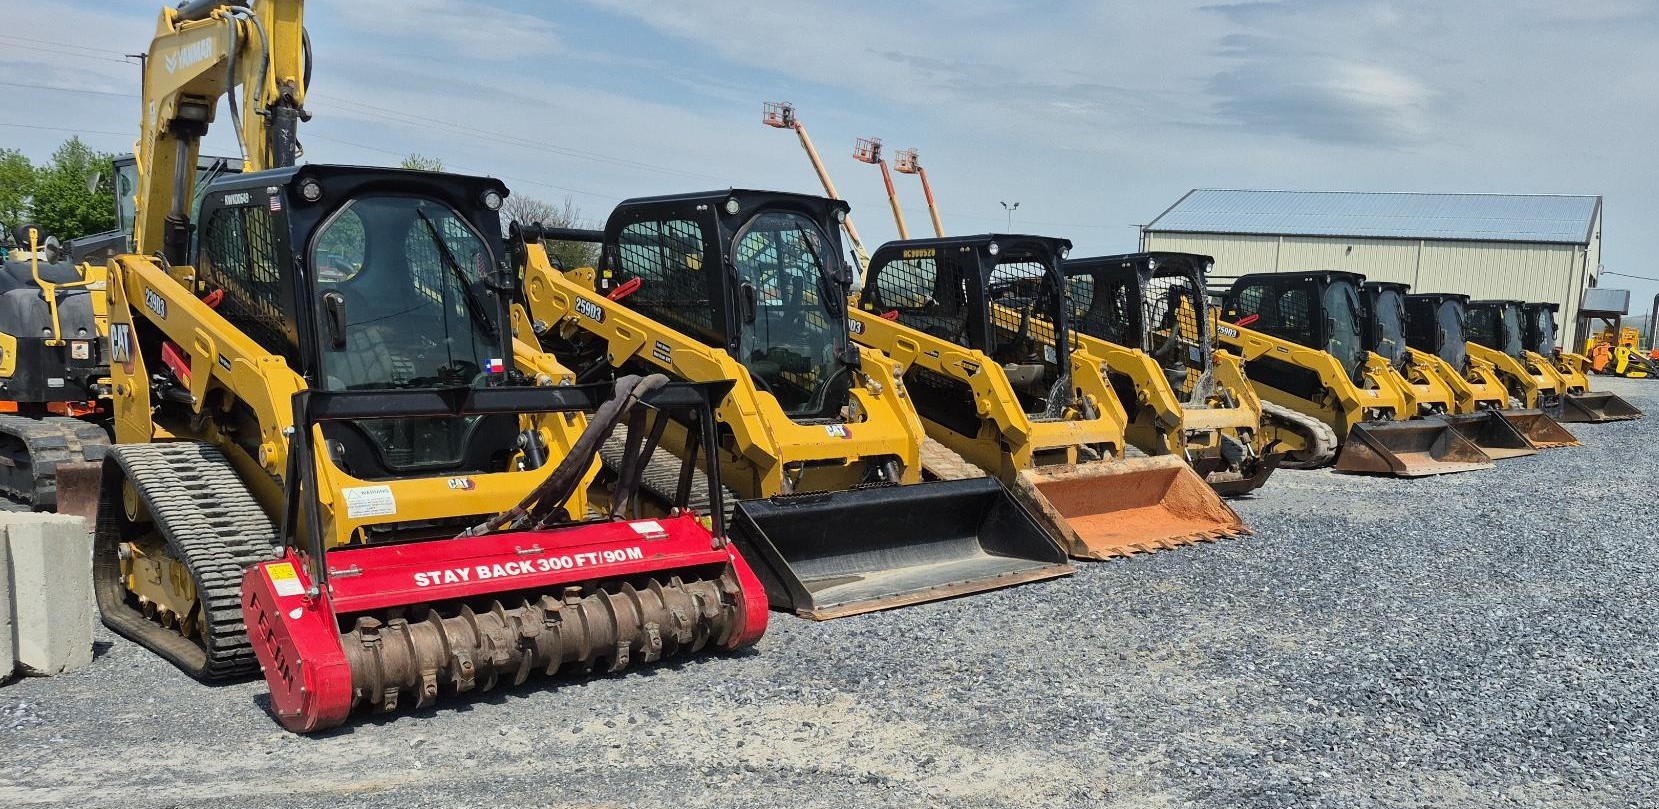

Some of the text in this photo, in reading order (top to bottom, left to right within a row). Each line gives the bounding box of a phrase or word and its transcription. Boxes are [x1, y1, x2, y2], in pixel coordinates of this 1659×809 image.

[177, 37, 212, 70] YANMAR
[146, 288, 166, 317] 239D3
[576, 297, 602, 320] 259D3
[111, 324, 130, 361] CAT
[825, 425, 846, 437] CAT
[448, 478, 469, 490] CAT
[414, 568, 469, 586] STAY
[477, 560, 534, 579] BACK
[538, 555, 573, 571] 300
